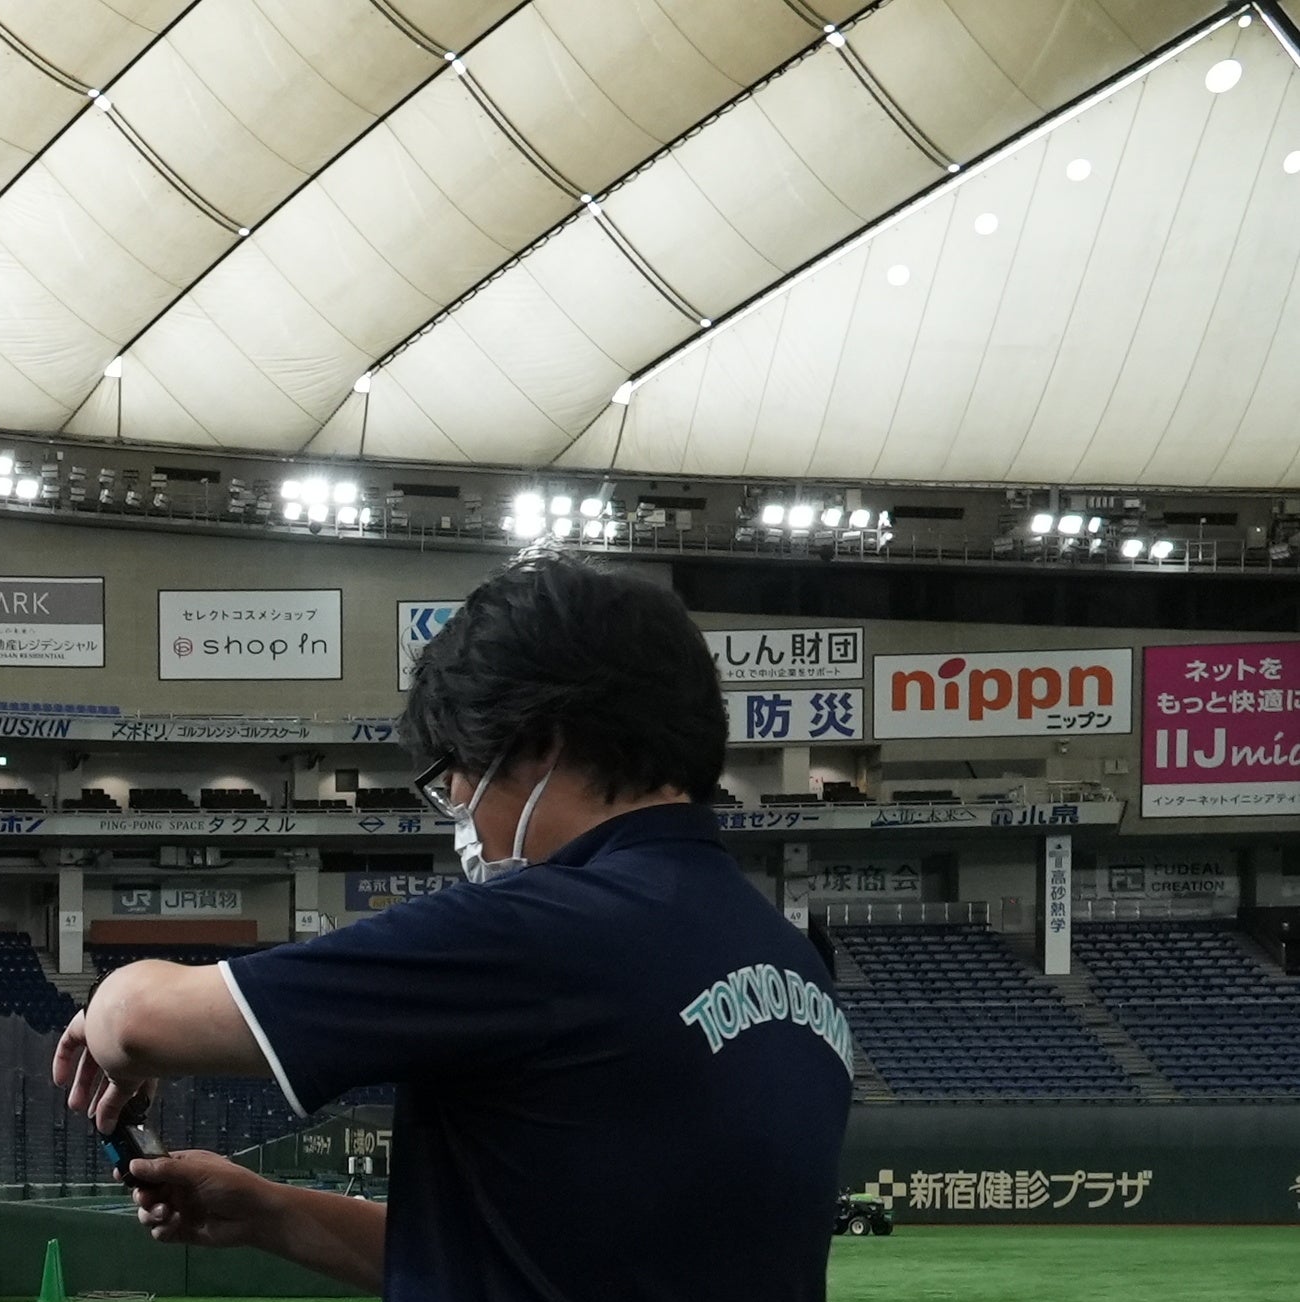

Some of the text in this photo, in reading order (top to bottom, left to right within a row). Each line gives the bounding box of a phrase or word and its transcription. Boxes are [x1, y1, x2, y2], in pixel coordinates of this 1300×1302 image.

[182, 609, 317, 622] セレクトコスメショップ
[714, 632, 858, 666] しん財団
[1185, 657, 1283, 682] ネットを
[892, 658, 1113, 720] nippn
[1157, 689, 1300, 714] もっと快適に
[1047, 711, 1112, 729] ニップン
[177, 726, 310, 739] ゴルフレンジ・ゴルフスクール
[1153, 794, 1300, 806] インターネットイニシアティ
[101, 817, 296, 833] PING-PONG SPACE タクスル
[1019, 805, 1079, 824] 小泉
[808, 864, 919, 892] 塚商会
[1152, 881, 1224, 892] CREATION
[165, 891, 237, 908] JR貨物
[1050, 869, 1067, 934] 高砂熱学
[679, 962, 855, 1081] TOKYO DOM
[909, 1169, 1153, 1210] 新宿健診プラザ
